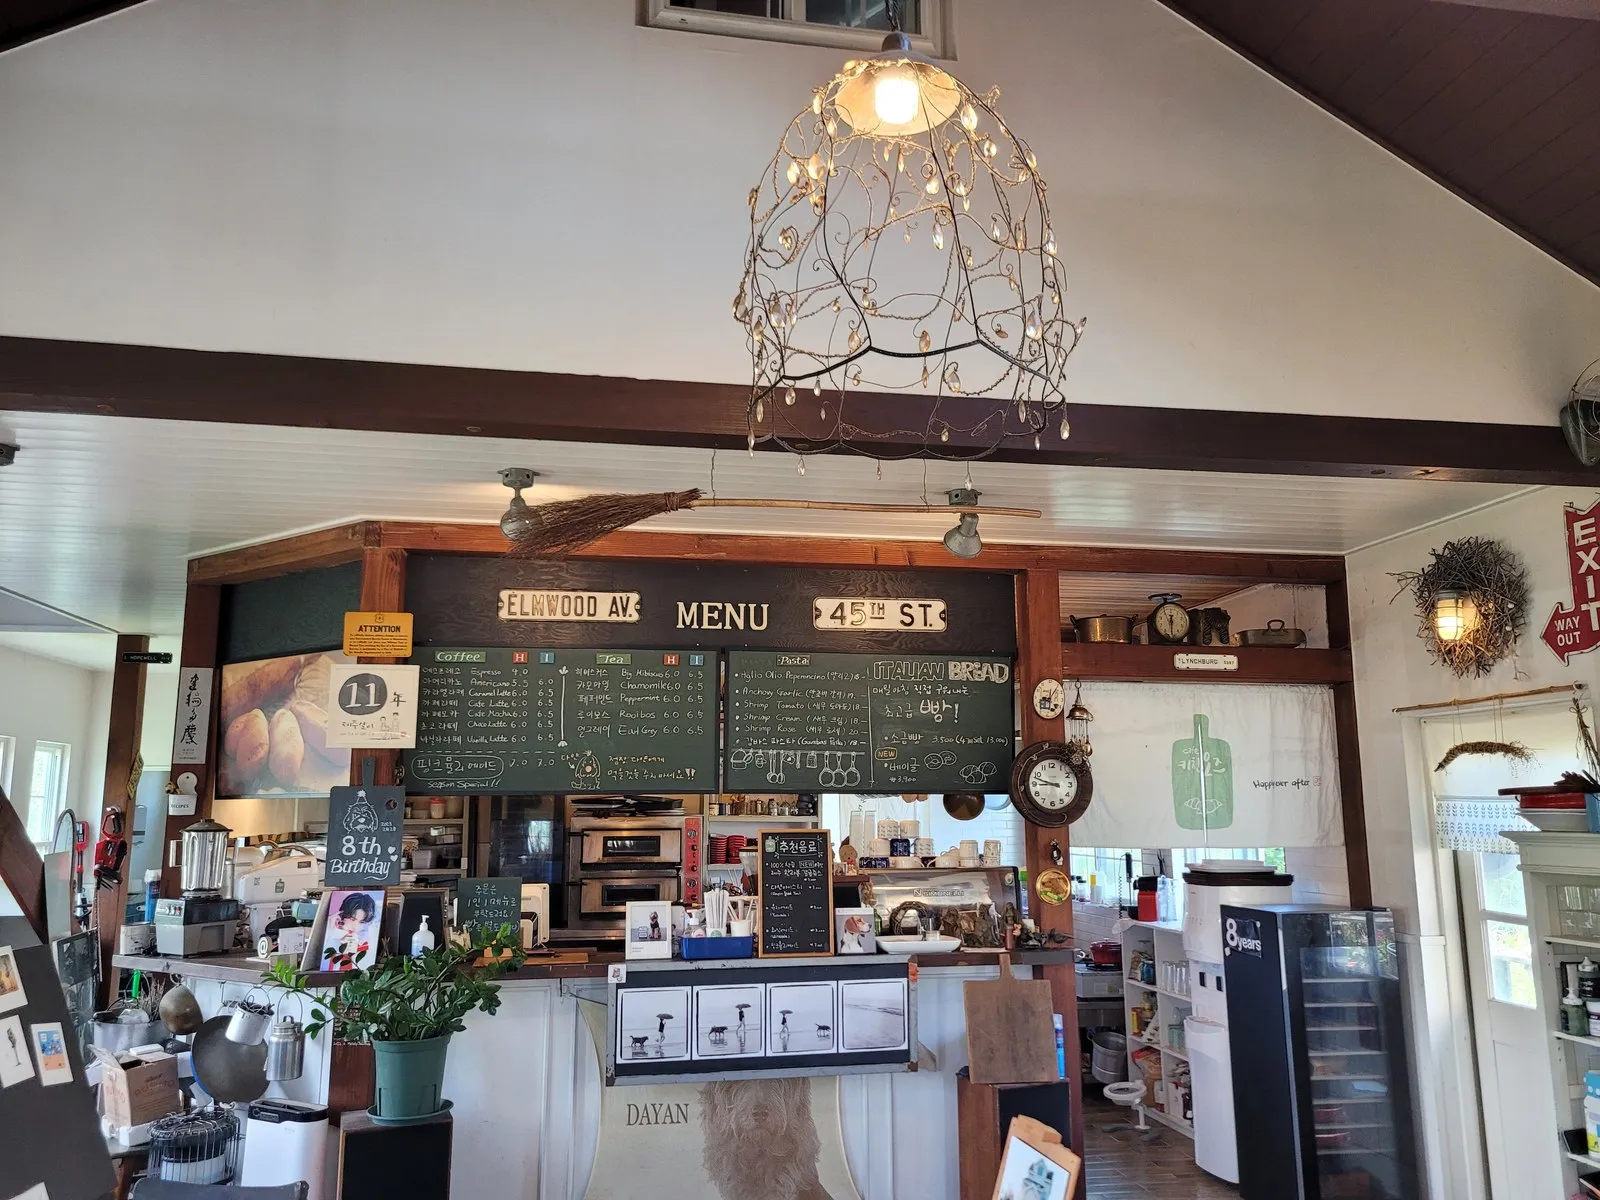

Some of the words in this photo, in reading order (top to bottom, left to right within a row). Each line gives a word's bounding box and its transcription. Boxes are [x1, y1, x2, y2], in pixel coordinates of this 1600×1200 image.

[1573, 517, 1600, 631] EXIT
[507, 592, 598, 618] ELMWOOD
[608, 595, 634, 618] AV.
[676, 601, 770, 630] MENU
[900, 603, 934, 628] ST.
[358, 625, 401, 633] ATTENTION
[1554, 616, 1581, 631] WAY
[1557, 632, 1581, 646] OUT
[437, 652, 481, 662] Coffee
[516, 653, 525, 662] H
[600, 654, 624, 664] Tea
[667, 656, 675, 665] H
[471, 667, 501, 677] Espresso
[621, 668, 633, 679] Big
[873, 661, 944, 681] ITALIAN
[948, 661, 1009, 684] BREAD
[470, 678, 510, 687] Americano
[620, 680, 667, 690] Chamomile
[345, 682, 381, 708] 11
[468, 688, 496, 697] Caramel
[742, 686, 773, 699] Anchovy
[777, 687, 802, 697] Garlic
[468, 699, 485, 707] Cafe
[489, 699, 510, 708] Latte
[620, 693, 660, 705] Peppermint
[744, 701, 769, 711] Shrimp
[777, 701, 804, 709] Tomato
[487, 710, 512, 718] Mocha
[620, 710, 656, 719] Rooibos
[743, 714, 771, 725] Shrimp
[745, 724, 771, 735] Shrimp
[777, 724, 797, 732] Rose
[780, 840, 817, 854] 추천음료
[330, 857, 391, 880] Birthday
[475, 883, 496, 895] 주문은
[1226, 918, 1238, 946] 8
[1237, 938, 1262, 952] years
[626, 1103, 690, 1127] DAYAN
